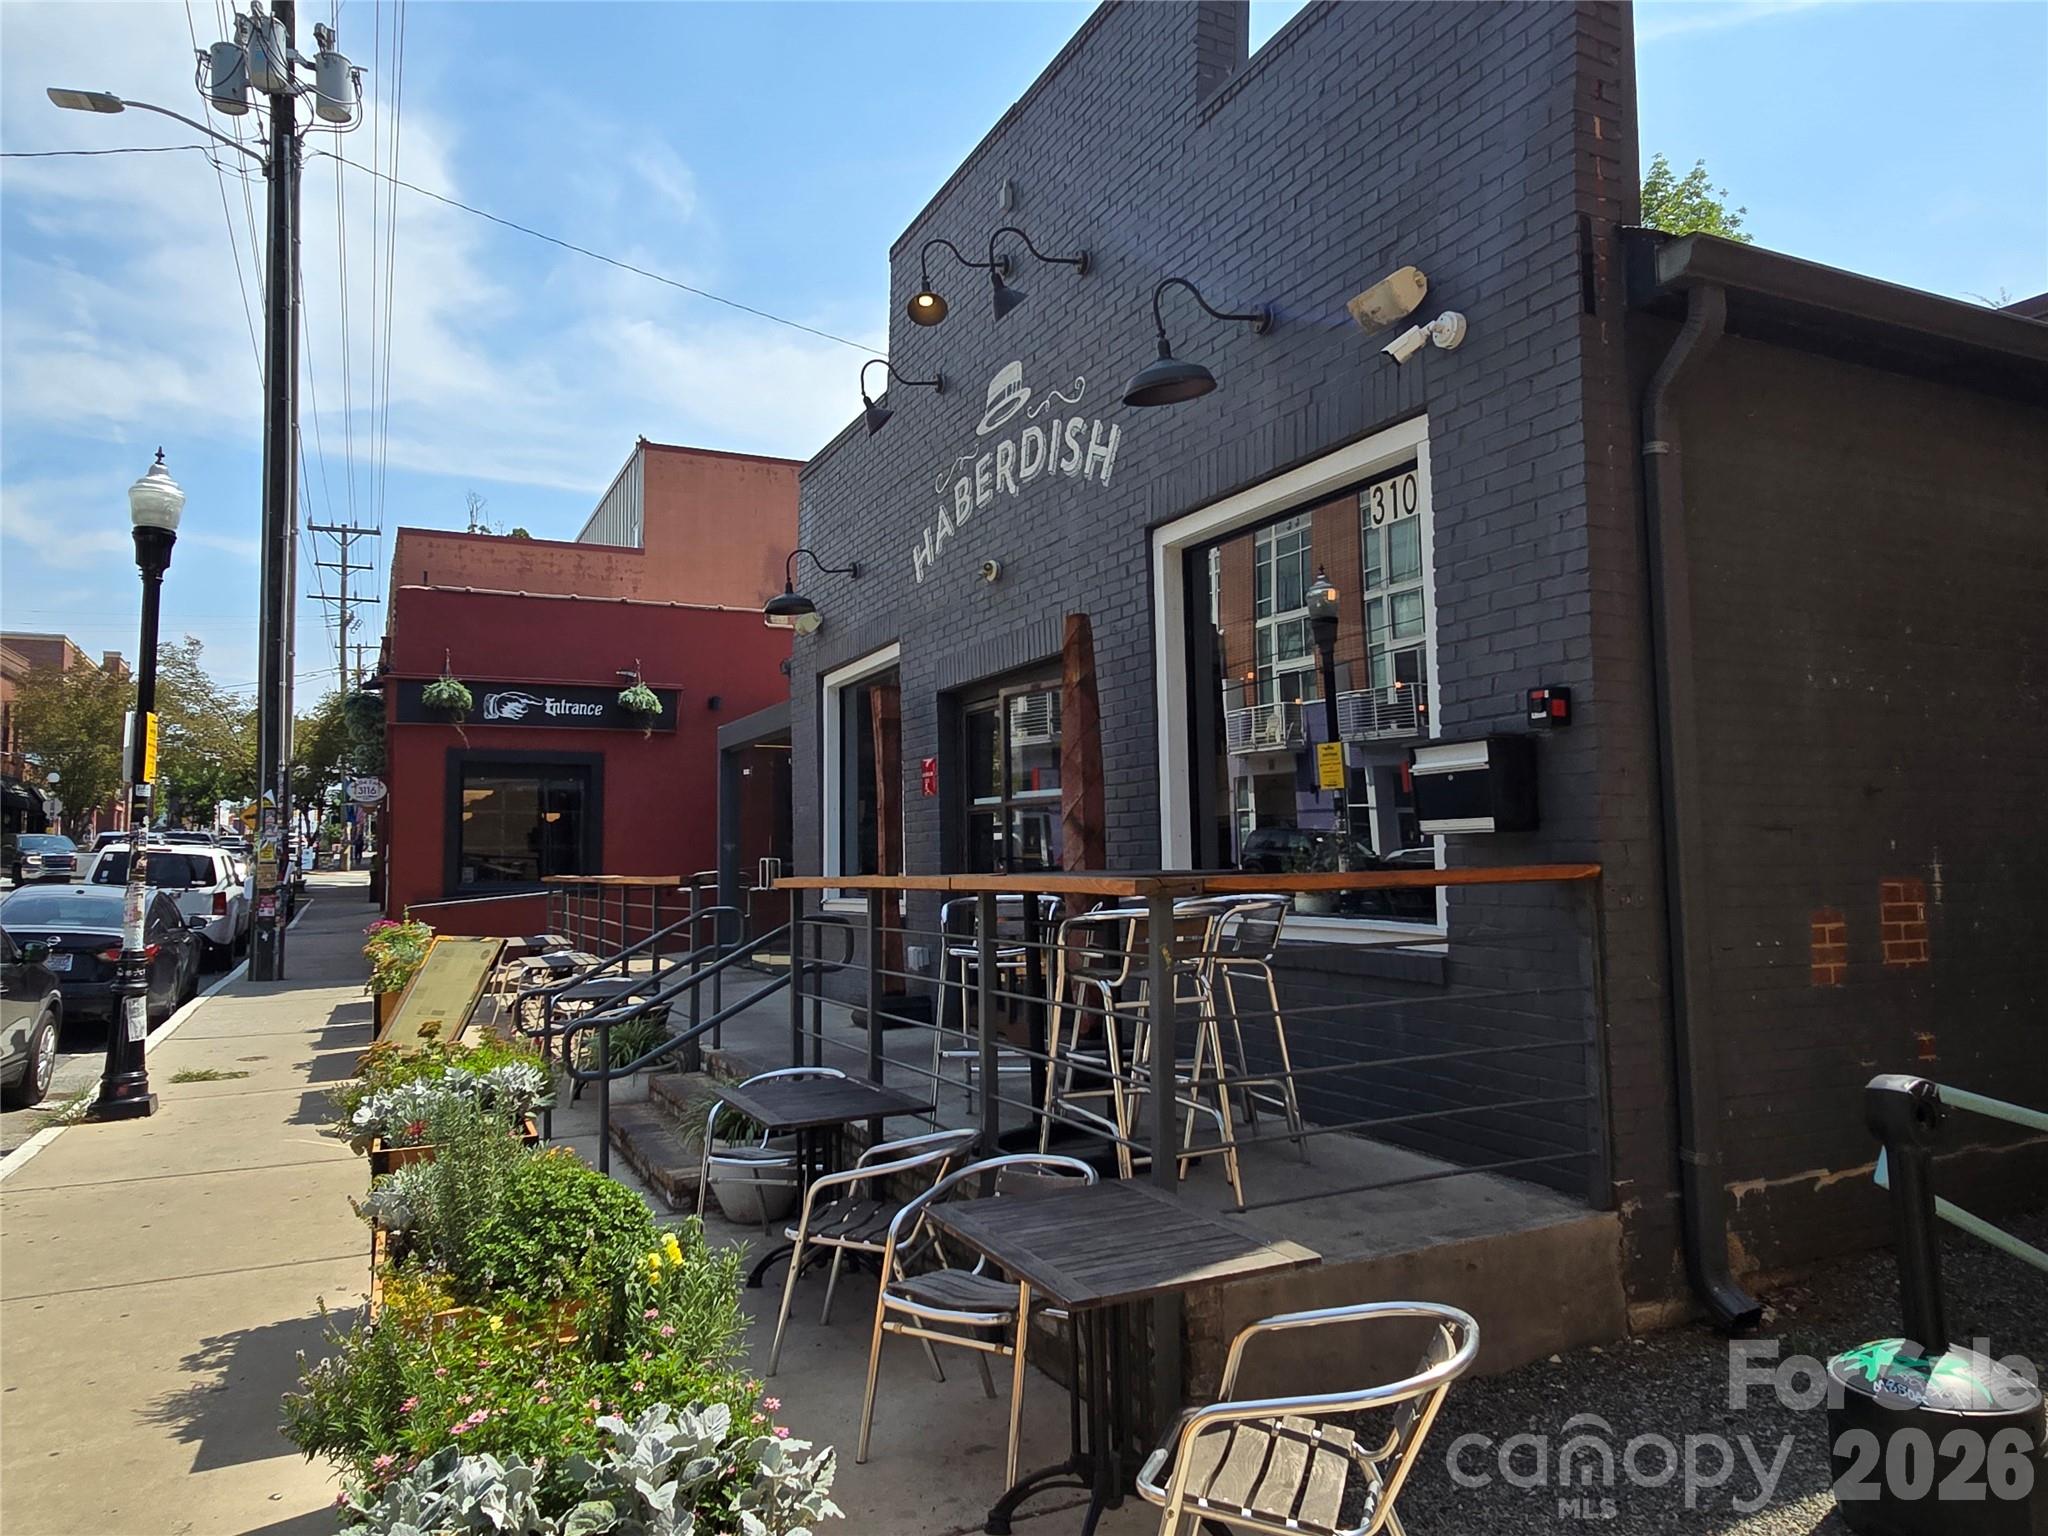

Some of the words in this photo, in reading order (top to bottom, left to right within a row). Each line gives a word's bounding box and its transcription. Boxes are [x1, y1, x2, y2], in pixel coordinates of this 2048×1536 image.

[912, 416, 1122, 584] HABERDISH
[1371, 473, 1418, 526] 310
[544, 696, 603, 717] Entrance
[357, 785, 377, 796] 3116
